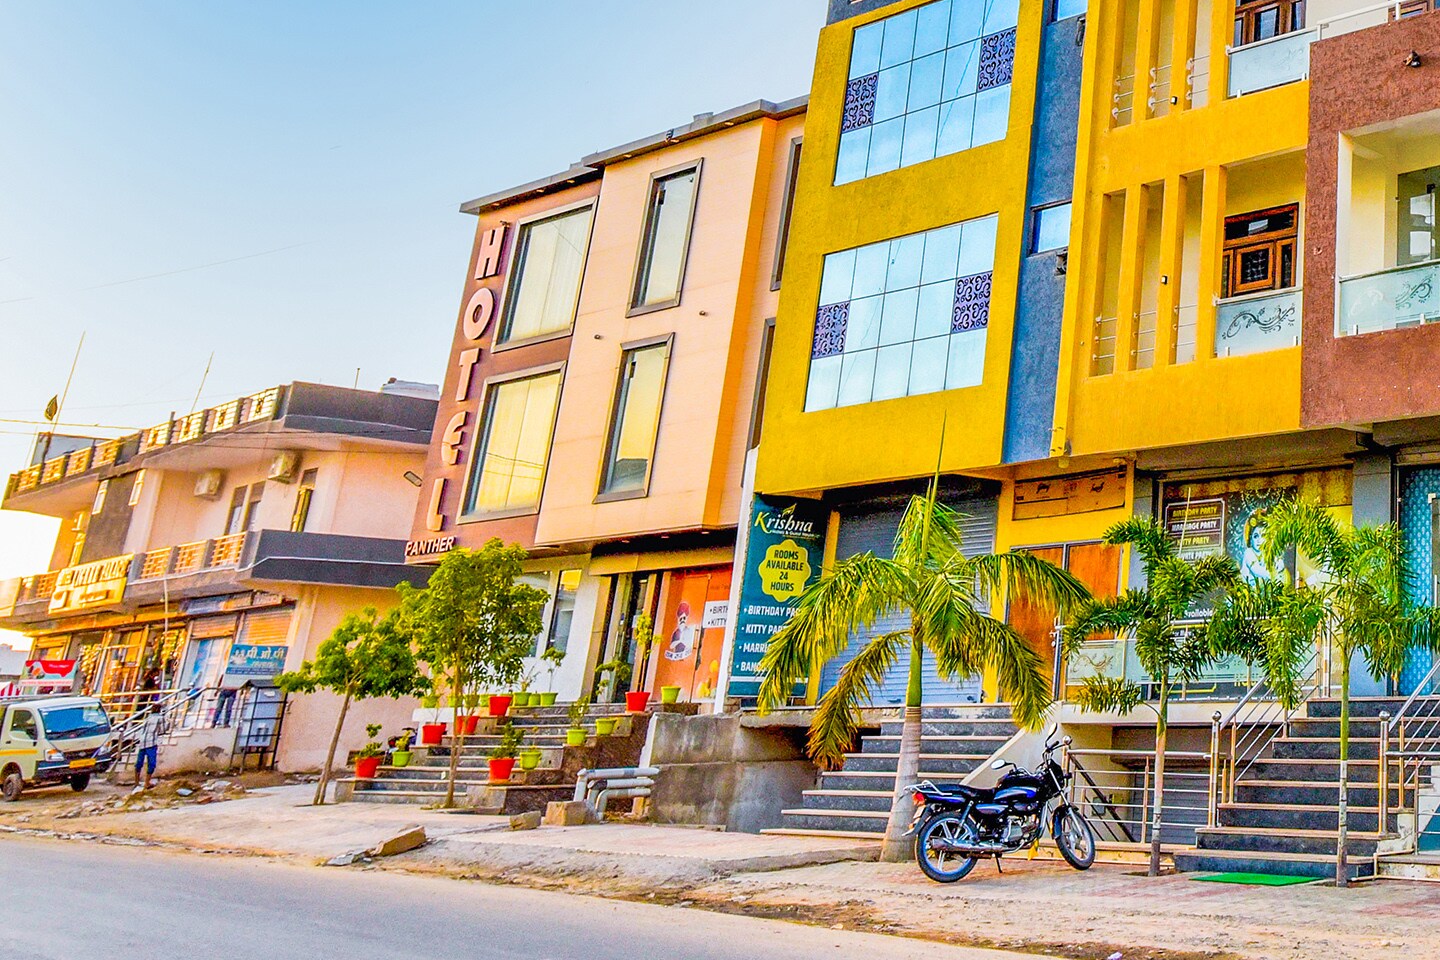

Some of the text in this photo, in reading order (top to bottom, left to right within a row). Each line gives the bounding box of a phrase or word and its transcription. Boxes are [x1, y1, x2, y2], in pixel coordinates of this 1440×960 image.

[427, 226, 507, 532] HOTEL
[754, 511, 814, 534] Krishna
[404, 535, 455, 556] PANTHER
[774, 550, 799, 560] ROOMS
[765, 560, 804, 571] AVAILABLE
[779, 572, 789, 580] 24
[770, 581, 795, 591] HOURS
[748, 605, 785, 617] BIRTHDAY
[745, 623, 767, 634] KITTY
